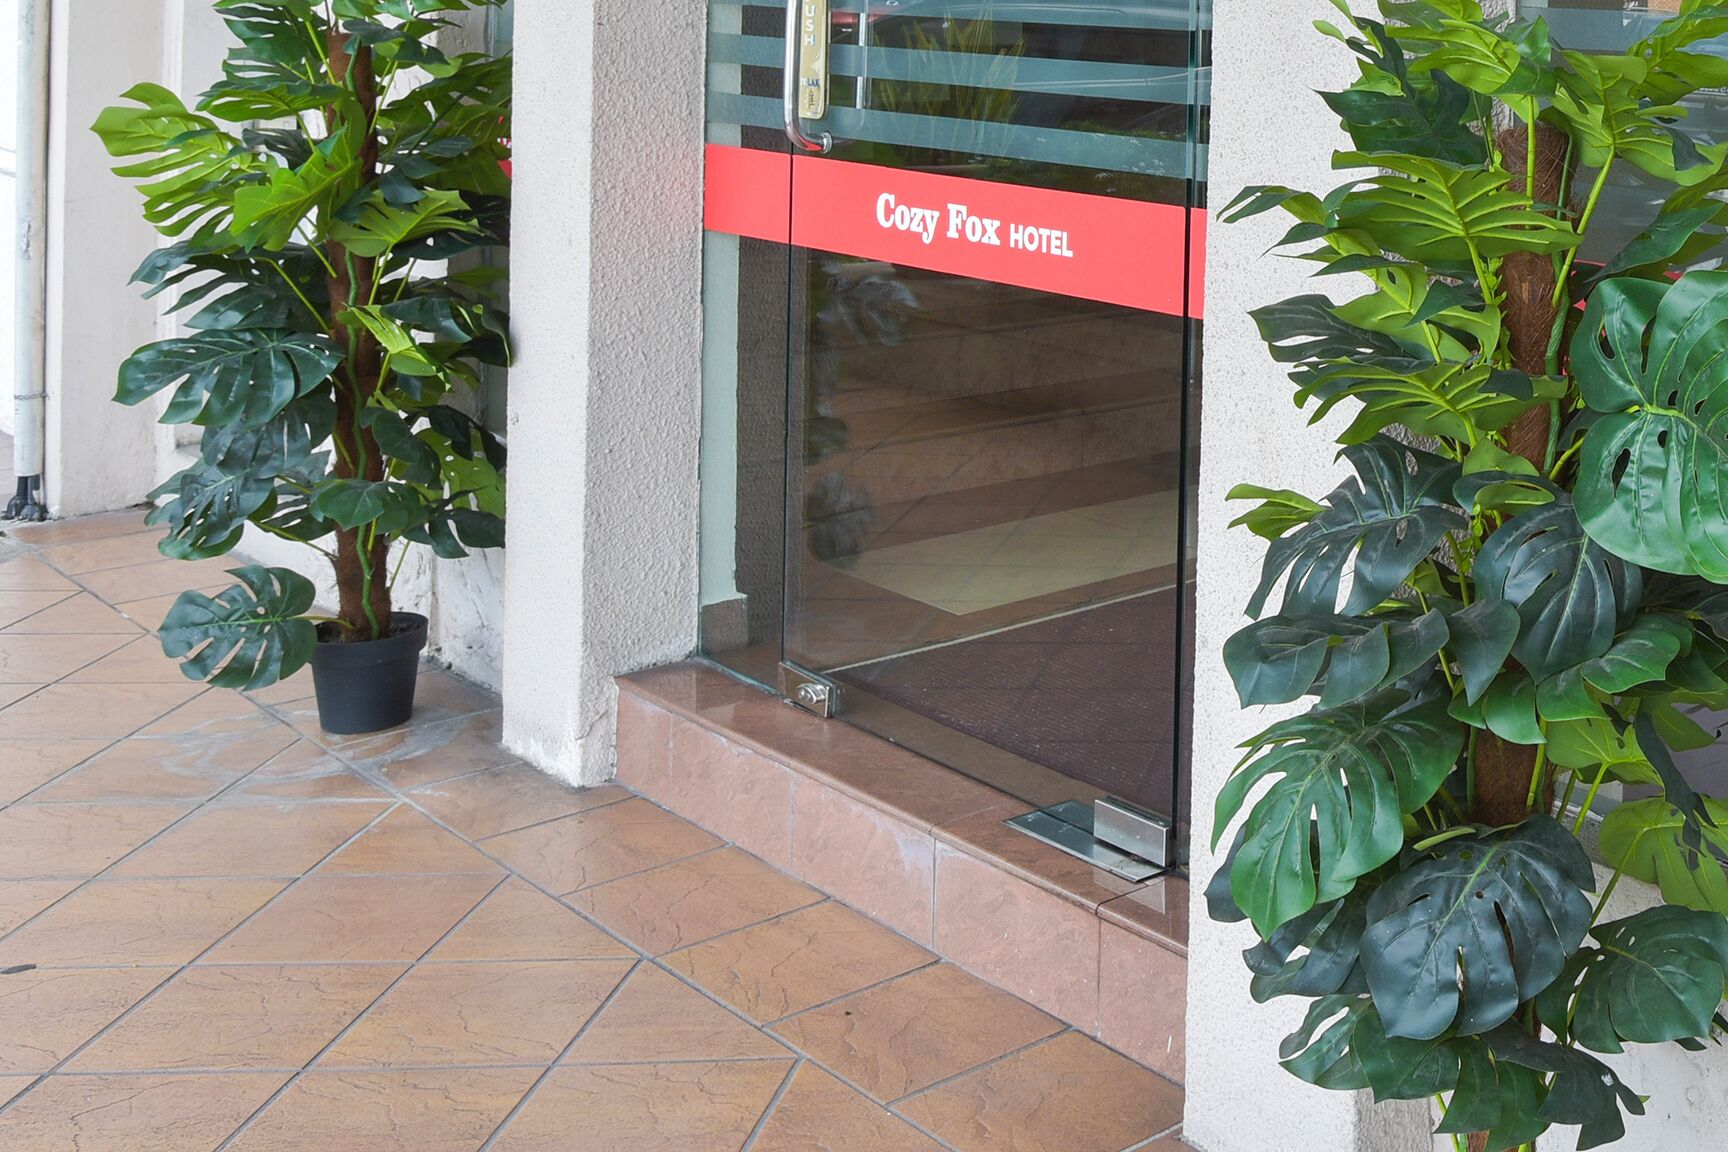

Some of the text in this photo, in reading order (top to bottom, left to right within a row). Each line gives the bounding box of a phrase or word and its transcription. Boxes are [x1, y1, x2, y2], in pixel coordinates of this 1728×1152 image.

[876, 192, 1073, 258] Cozy Fox HOTEL
